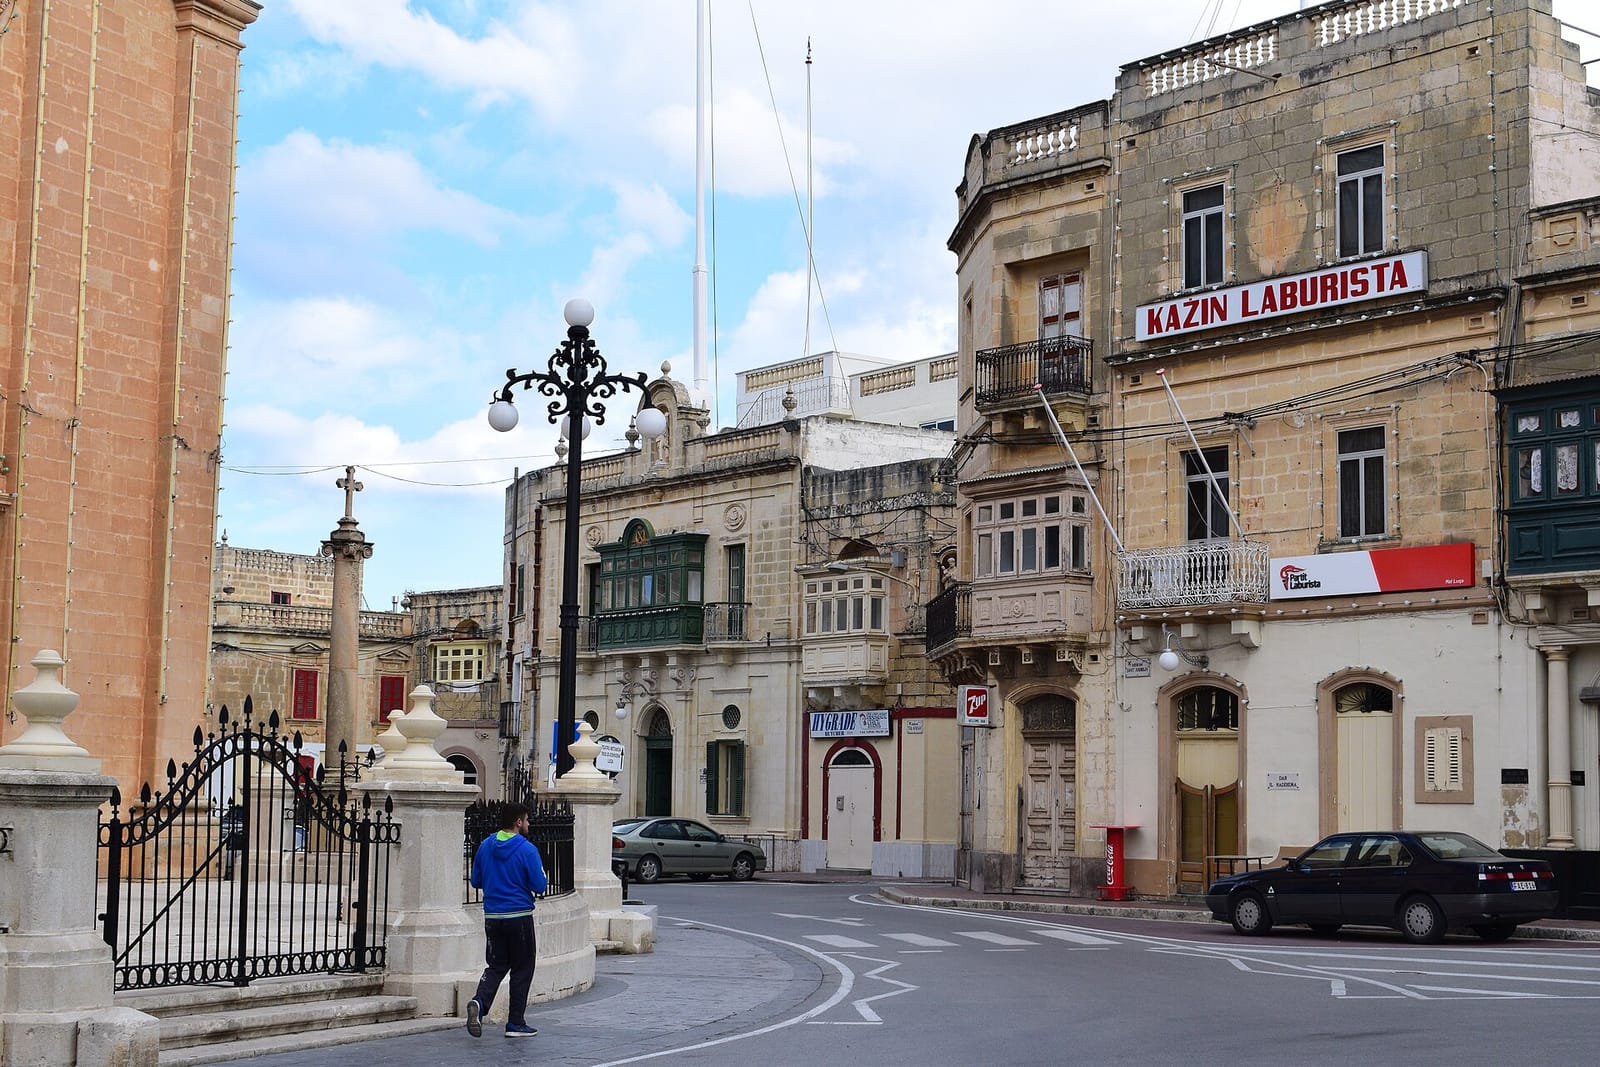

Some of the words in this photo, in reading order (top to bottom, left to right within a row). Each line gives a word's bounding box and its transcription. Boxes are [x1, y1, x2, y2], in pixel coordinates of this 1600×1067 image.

[1147, 294, 1228, 336] KAŻIN
[1241, 259, 1409, 318] LABURISTA
[1290, 572, 1307, 582] Partit
[1290, 579, 1321, 590] Laburista
[812, 712, 858, 731] HYGRADE
